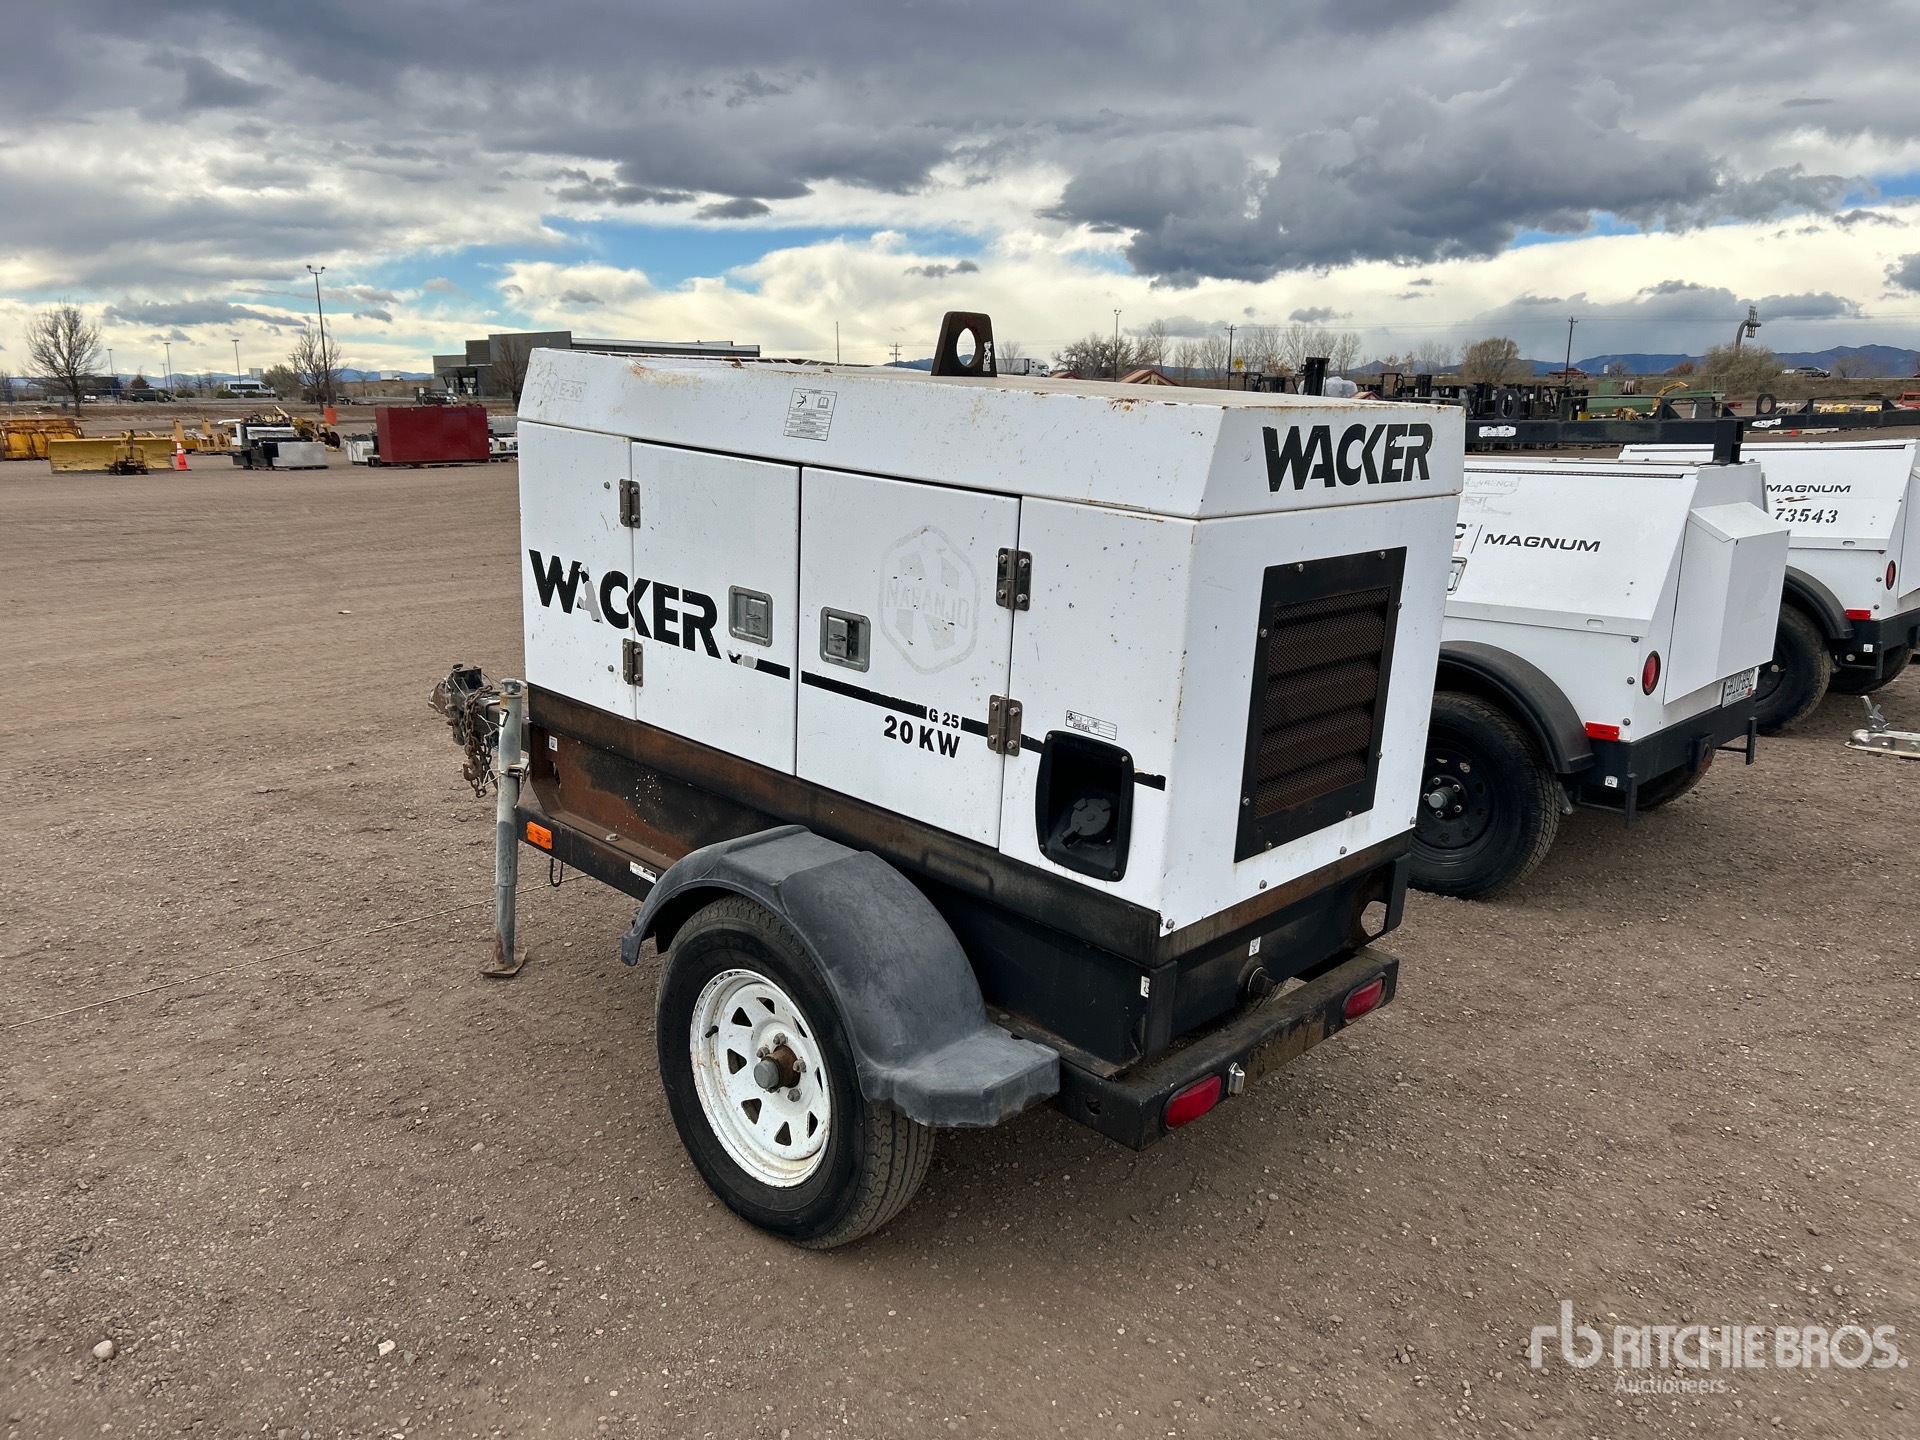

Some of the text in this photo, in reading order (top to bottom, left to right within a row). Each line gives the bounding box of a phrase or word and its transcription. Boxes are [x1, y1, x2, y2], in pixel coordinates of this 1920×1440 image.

[1262, 423, 1433, 493] WACKER
[1766, 484, 1852, 493] MAGNUM
[1775, 508, 1838, 524] 73543
[1484, 533, 1601, 552] MAGNUM
[528, 549, 722, 660] WACKER
[928, 708, 959, 729] G 25
